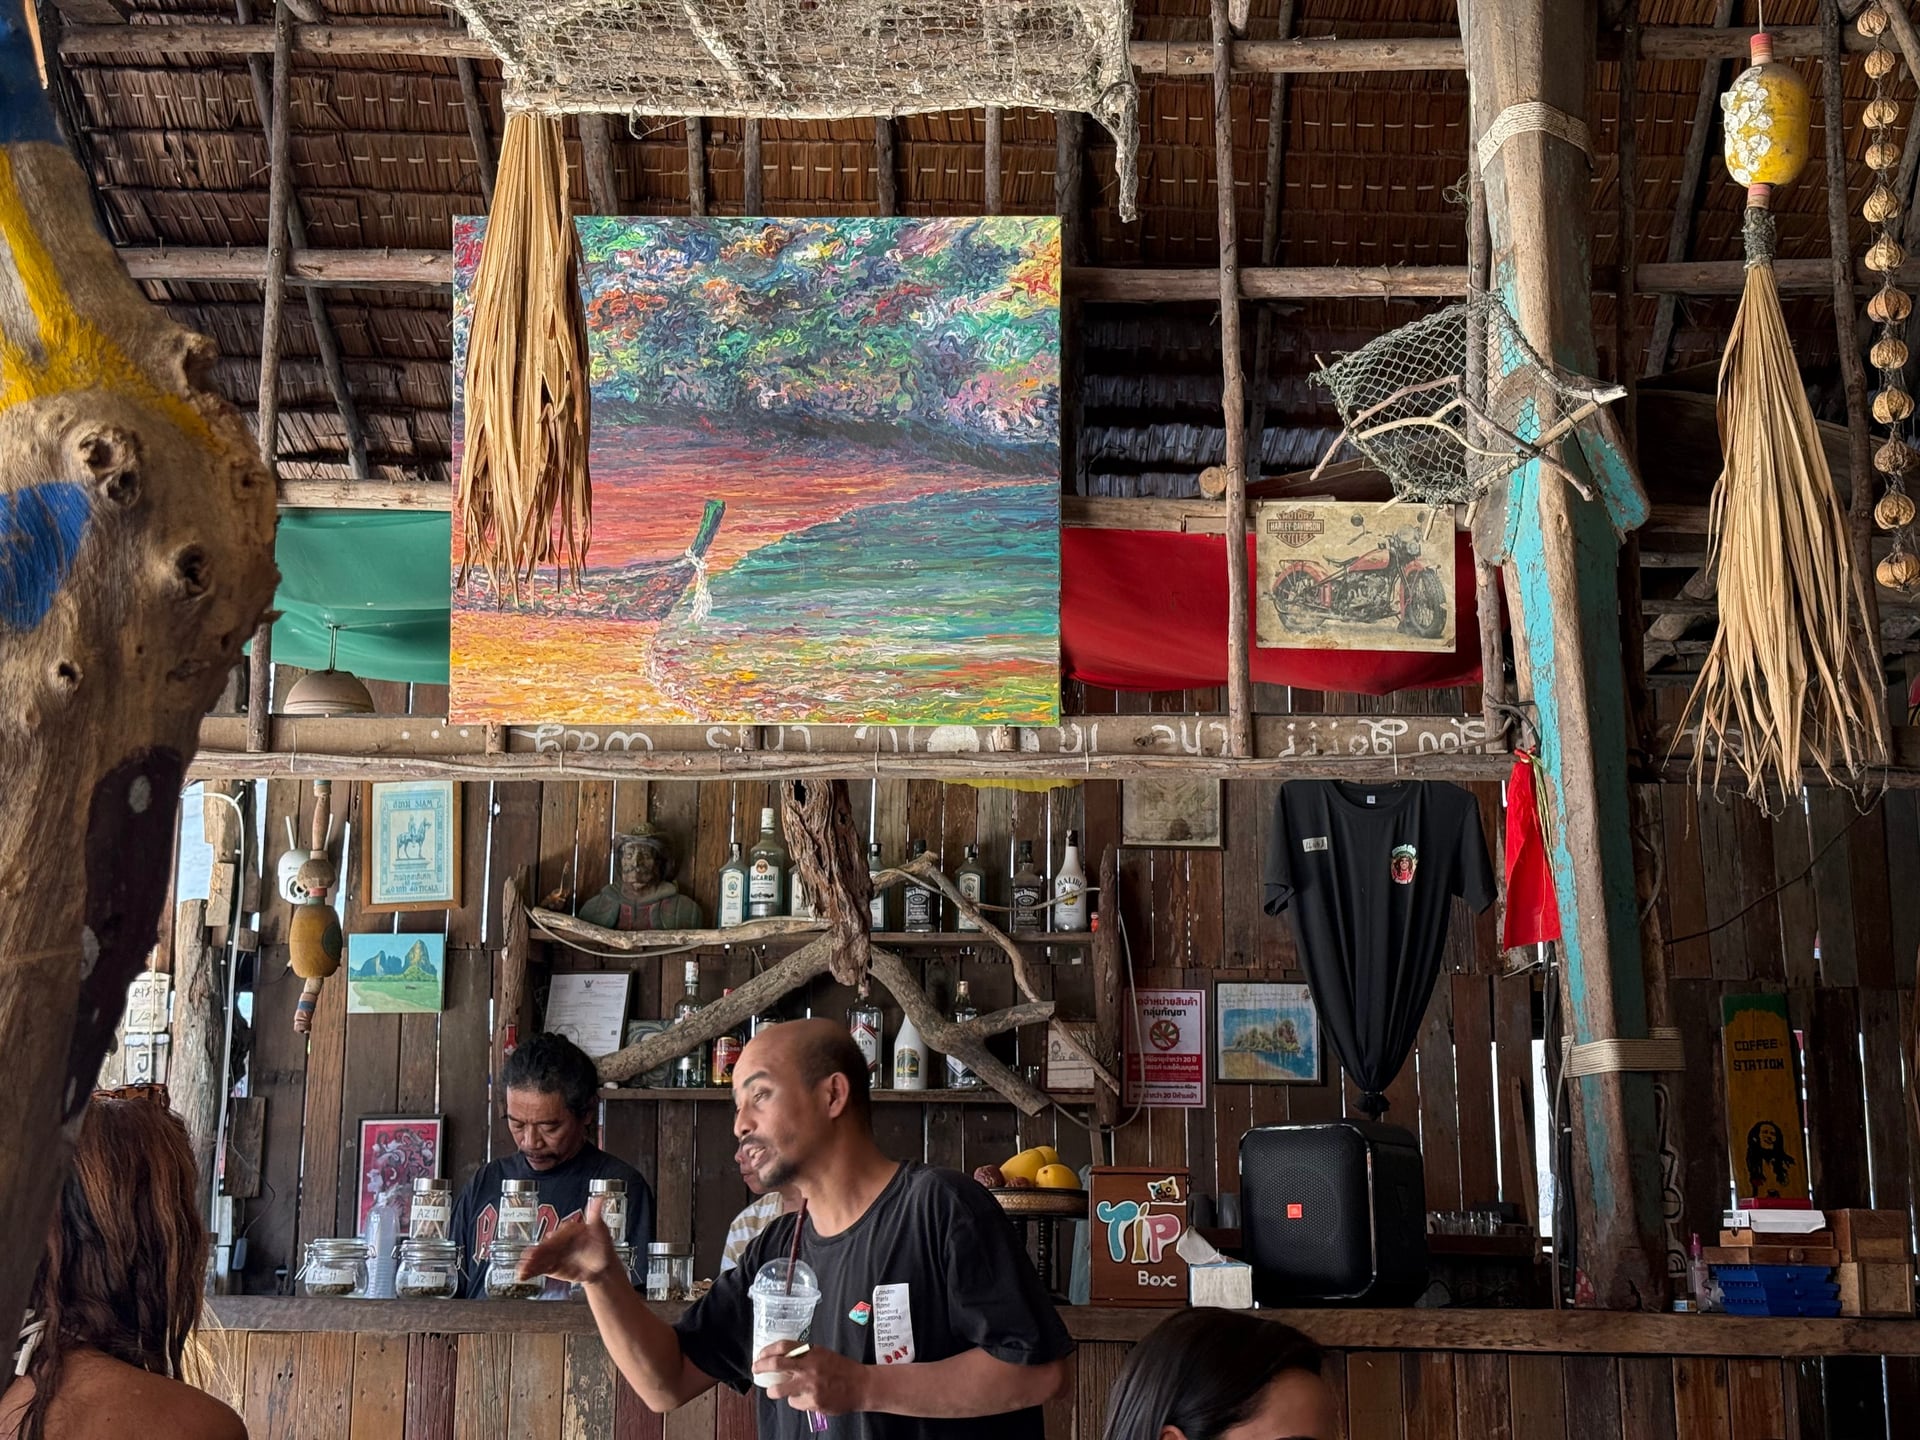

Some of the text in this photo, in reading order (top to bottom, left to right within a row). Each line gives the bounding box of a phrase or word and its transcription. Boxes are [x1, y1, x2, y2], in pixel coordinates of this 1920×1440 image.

[1270, 521, 1321, 531] HARLEY-DAVIDSON
[415, 799, 432, 808] SIAM
[1734, 1038, 1778, 1052] COFFEE
[1733, 1058, 1784, 1072] STATION
[416, 1208, 431, 1218] AZ
[1137, 1270, 1178, 1288] Box
[884, 1344, 908, 1364] DAY
